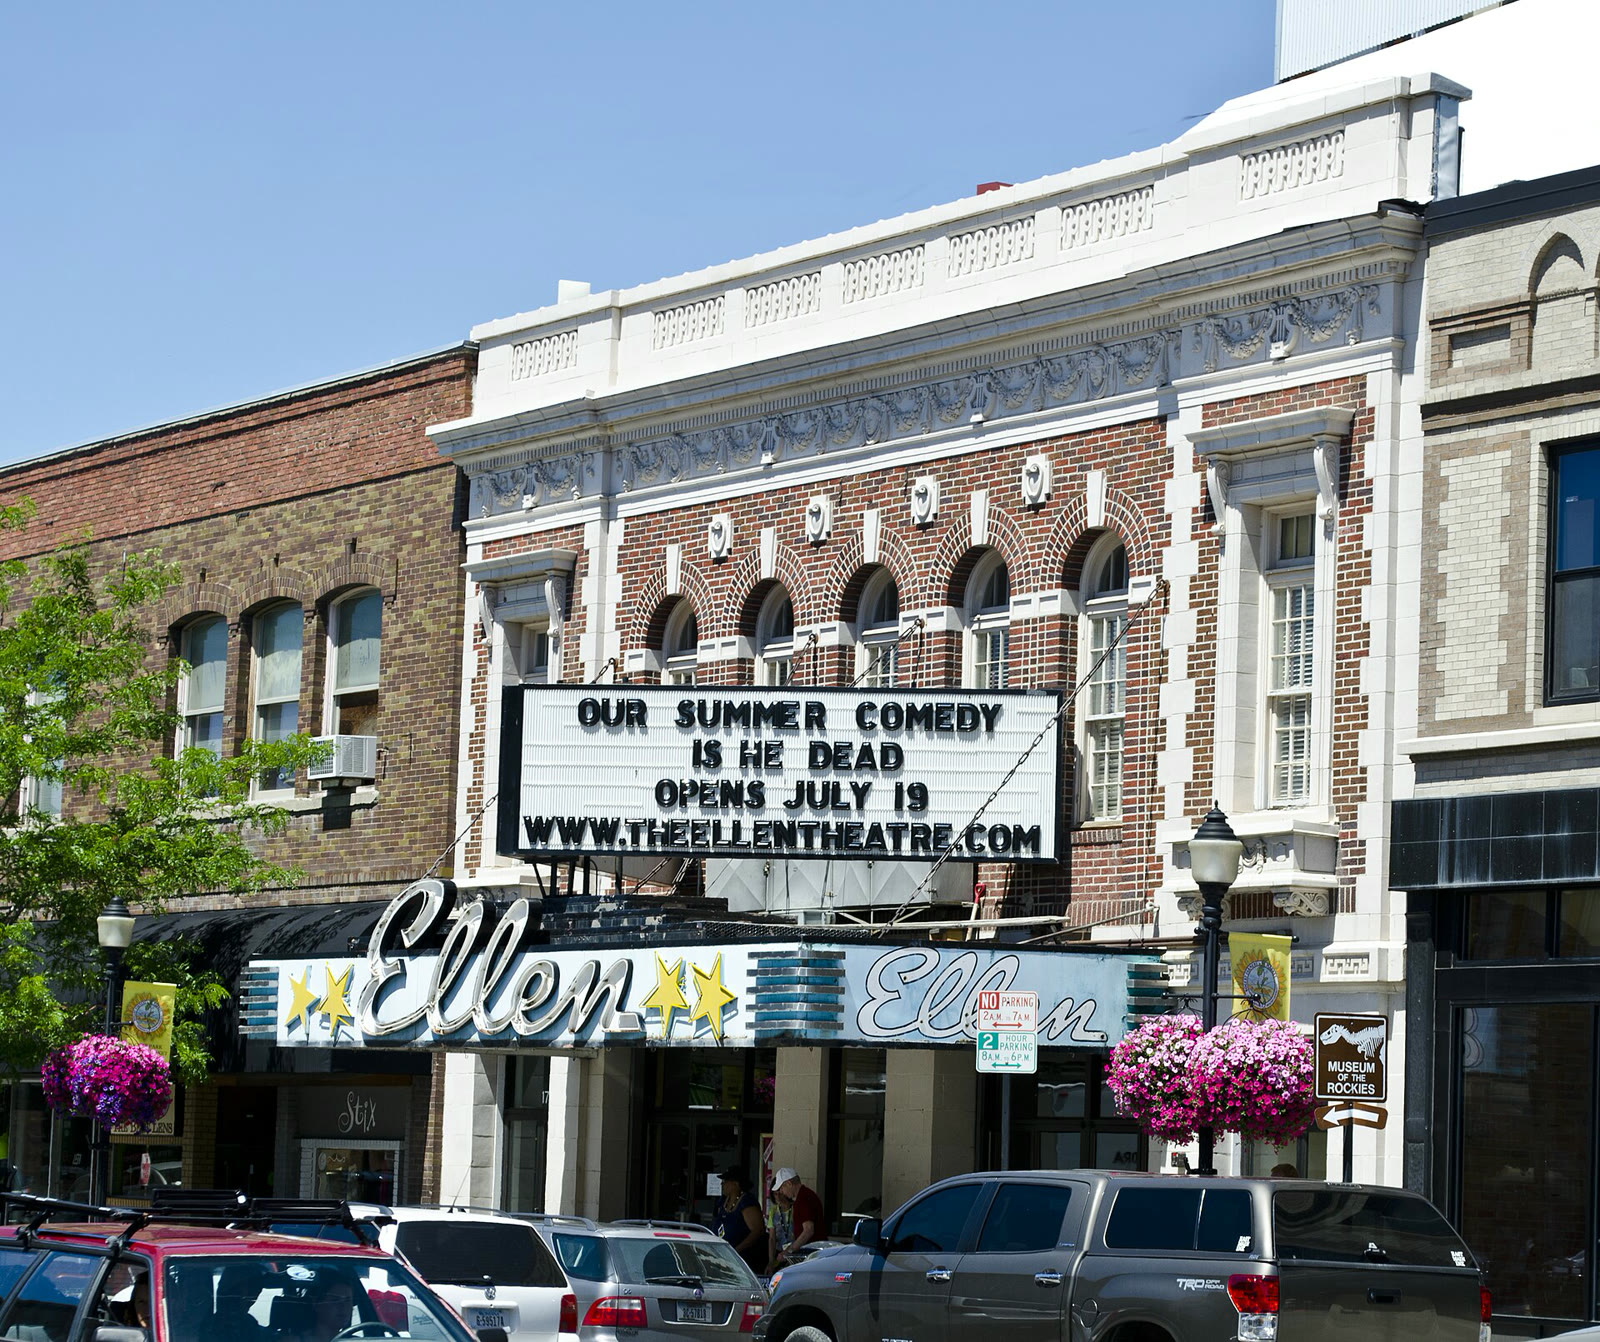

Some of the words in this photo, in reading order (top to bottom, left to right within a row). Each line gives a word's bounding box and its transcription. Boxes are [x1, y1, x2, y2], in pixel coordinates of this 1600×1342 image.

[577, 697, 648, 728] OUR
[676, 699, 827, 731] SUMMER
[855, 702, 1003, 733] COMEDY
[693, 739, 722, 768] IS
[740, 740, 784, 770] HE
[808, 741, 904, 772] DEAD
[655, 779, 766, 809] OPENS
[783, 780, 872, 811] JULY
[894, 782, 929, 812] 19
[523, 815, 1041, 854] WWW.THEELLENTHEATRE.COM
[358, 878, 647, 1036] Ellen
[857, 946, 1109, 1043] Elln
[982, 993, 998, 1009] NO
[1001, 996, 1034, 1008] PARKING
[982, 1033, 994, 1049] 2
[1005, 1034, 1028, 1042] HOUR
[1000, 1042, 1033, 1052] PARKING
[1327, 1061, 1376, 1074] MUSEUM
[1337, 1073, 1349, 1082] OF
[1351, 1073, 1366, 1082] THE
[1327, 1082, 1376, 1095] ROCKIES
[338, 1091, 377, 1134] Stix
[152, 1122, 173, 1134] LENS
[1176, 1278, 1206, 1291] TRD
